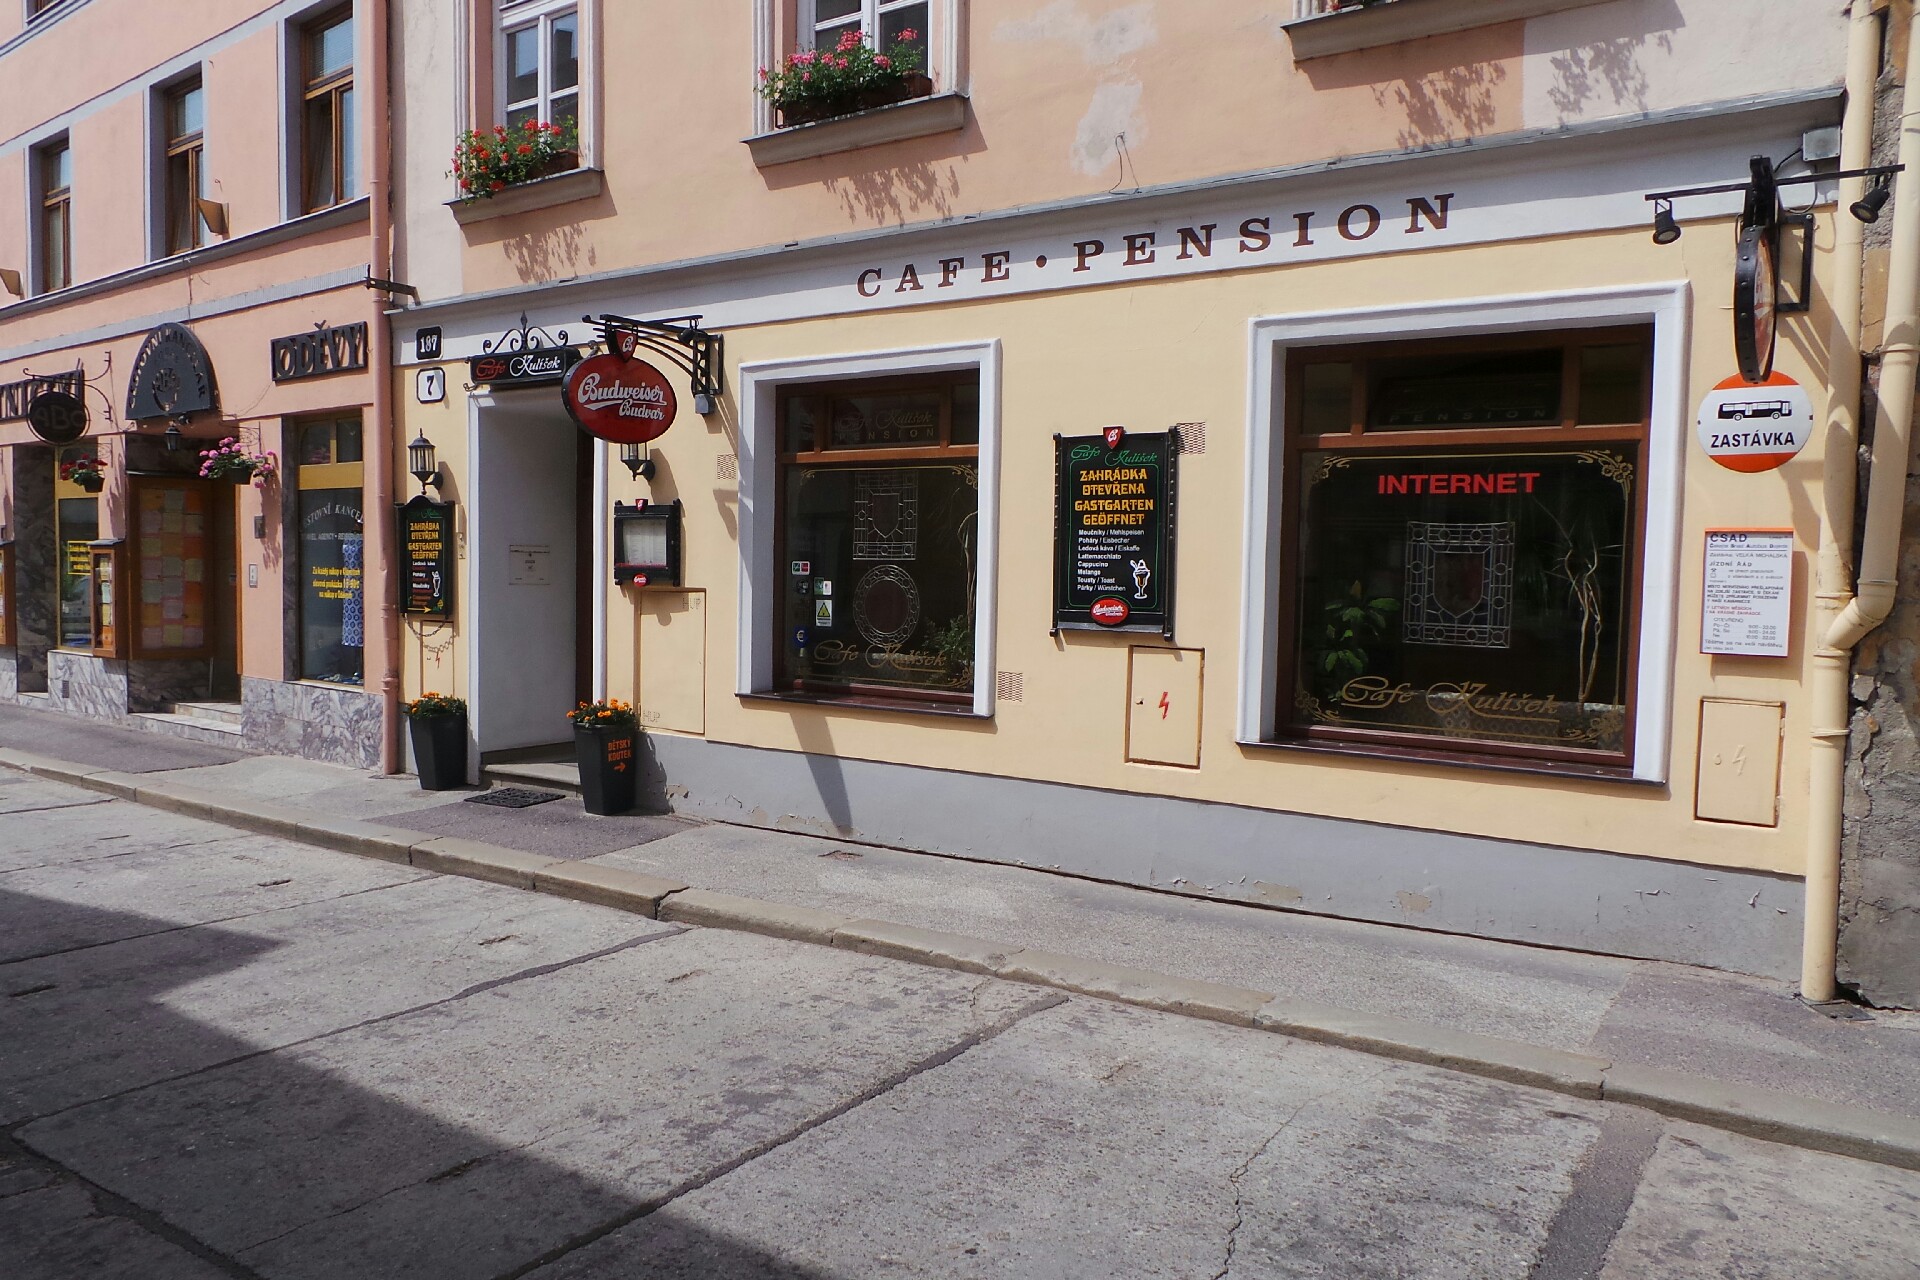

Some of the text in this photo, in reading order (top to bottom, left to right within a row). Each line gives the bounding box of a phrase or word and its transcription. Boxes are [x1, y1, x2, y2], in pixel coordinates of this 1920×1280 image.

[857, 193, 1454, 298] CAFE PENSION
[274, 320, 364, 377] ODĚVY
[420, 334, 438, 352] 187
[476, 354, 562, 380] Cafe Kulíšek
[426, 374, 434, 396] 7
[578, 372, 667, 404] Budweiser
[618, 399, 664, 420] Budvar
[1388, 409, 1546, 423] PENSION
[1711, 430, 1795, 449] ZASTÁVKA
[1080, 467, 1148, 482] ZAHRÁDKA
[1378, 472, 1540, 495] INTERNET
[1082, 480, 1146, 496] OTEVŘENA
[1074, 499, 1154, 511] GASTGARTEN
[1083, 512, 1144, 525] GEÖFFNET
[408, 542, 442, 550] GASTGARTEN
[814, 639, 946, 673] Cafe Kulíšek
[1340, 675, 1560, 722] Cafe Kulíšek
[608, 738, 631, 751] DĚTSKÝ
[608, 750, 632, 761] KOUTEK
